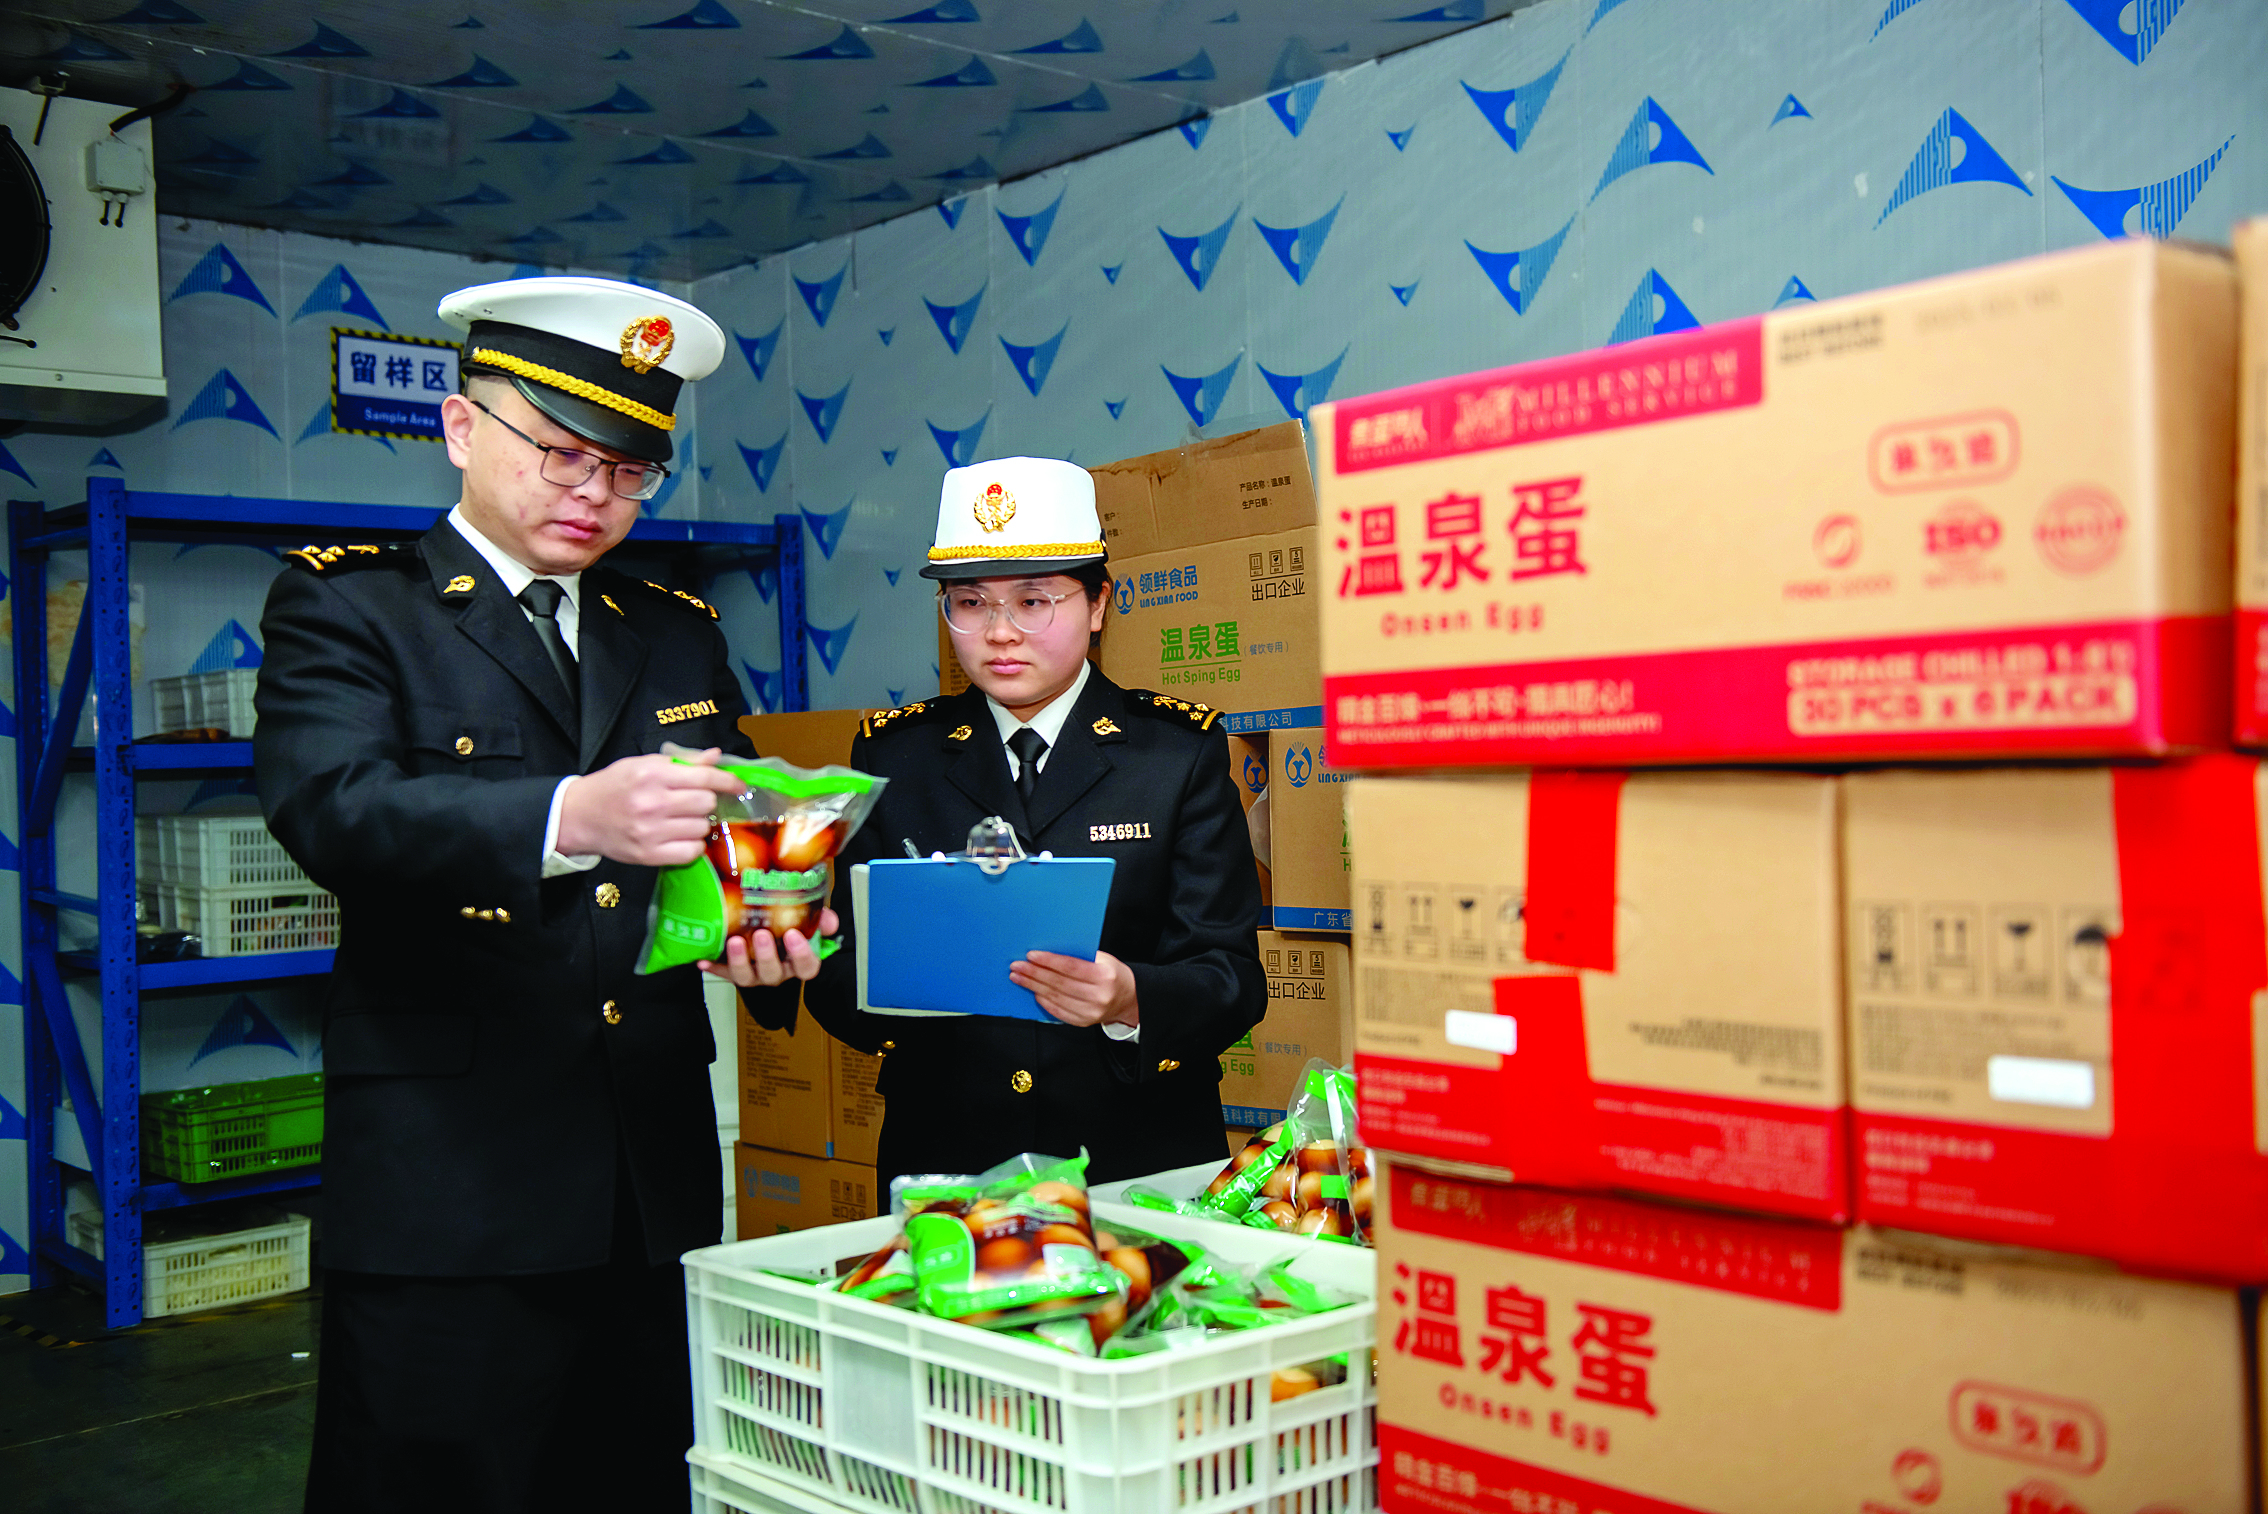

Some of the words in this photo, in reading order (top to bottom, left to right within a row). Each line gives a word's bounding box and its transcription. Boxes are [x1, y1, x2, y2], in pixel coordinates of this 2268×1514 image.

[350, 351, 448, 392] 留样区
[364, 406, 407, 425] Sample
[409, 411, 437, 428] Area
[1336, 476, 1588, 597] 溫泉蛋
[1139, 565, 1198, 594] 领鲜食品
[1251, 578, 1305, 601] 出口企业
[1139, 596, 1156, 608] LING
[1156, 593, 1174, 606] XIAN
[1175, 590, 1199, 603] FOOD
[1381, 608, 1472, 637] Onsen
[1485, 601, 1544, 634] Egg
[1160, 621, 1241, 664] 温泉蛋
[1162, 671, 1181, 686] Hot
[1183, 669, 1216, 686] Sping
[1218, 667, 1241, 682] Egg
[656, 699, 719, 725] 5337901
[1090, 822, 1151, 842] 5346911
[1268, 980, 1326, 1000] 出口企业
[1230, 1058, 1255, 1076] Egg
[1392, 1259, 1660, 1419] 溫泉蛋
[1439, 1381, 1534, 1430] Onsen
[1549, 1409, 1611, 1456] Egg
